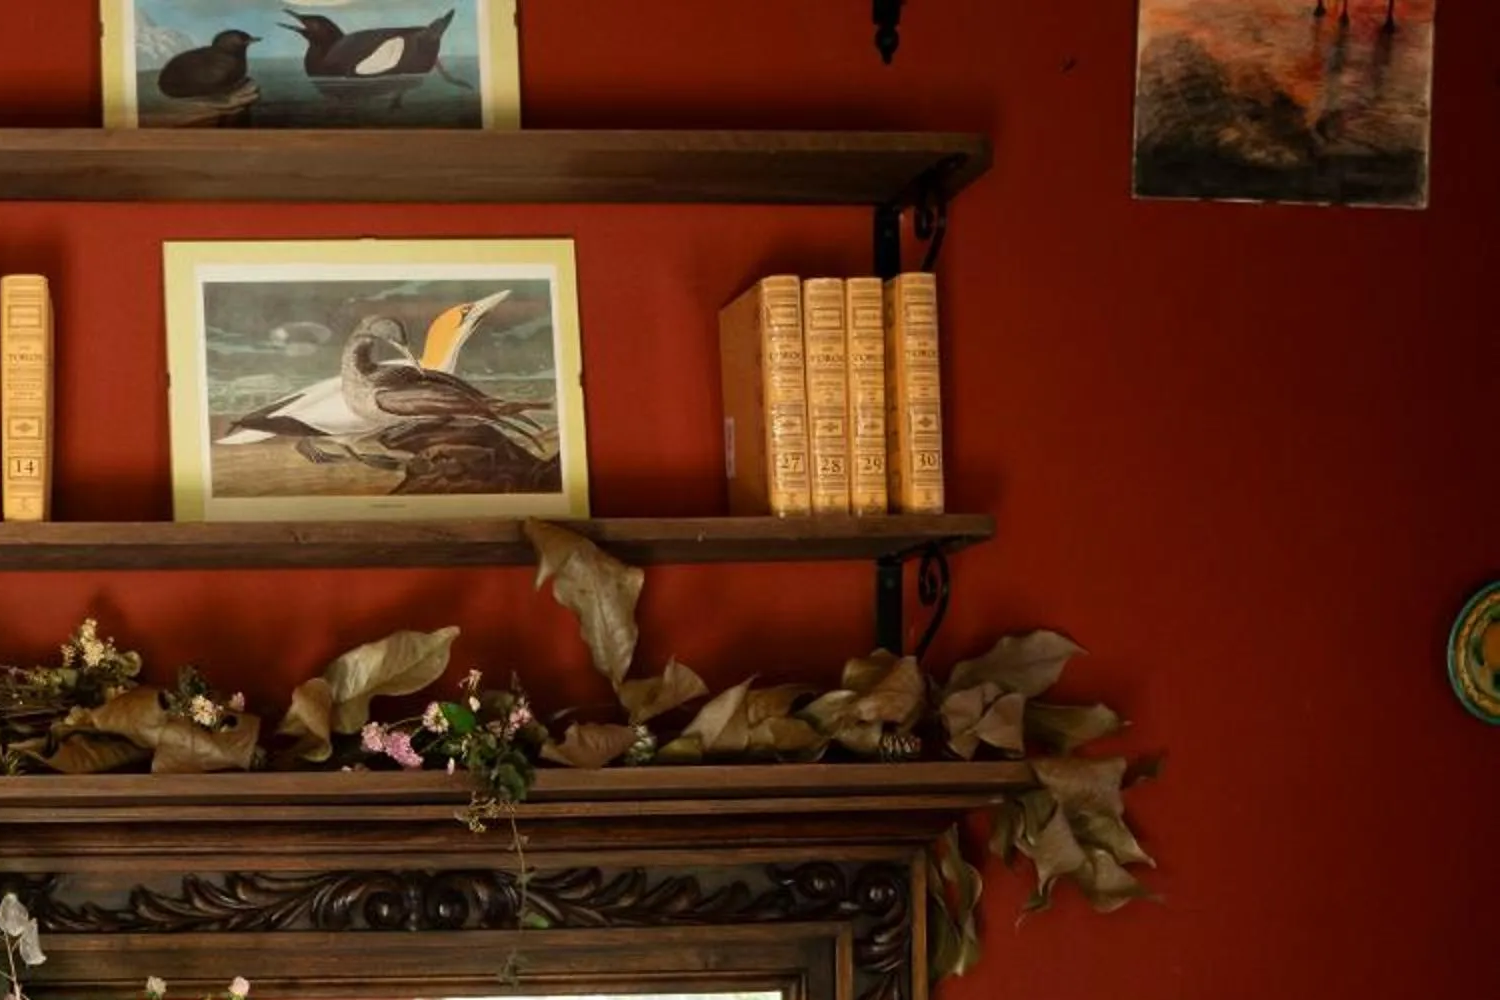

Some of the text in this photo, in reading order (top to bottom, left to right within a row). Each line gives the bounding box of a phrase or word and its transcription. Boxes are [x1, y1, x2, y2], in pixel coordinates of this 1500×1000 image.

[15, 459, 35, 475] 14
[781, 457, 800, 473] 27
[821, 458, 841, 474] 28
[863, 456, 883, 471] 29
[918, 453, 936, 467] 30
